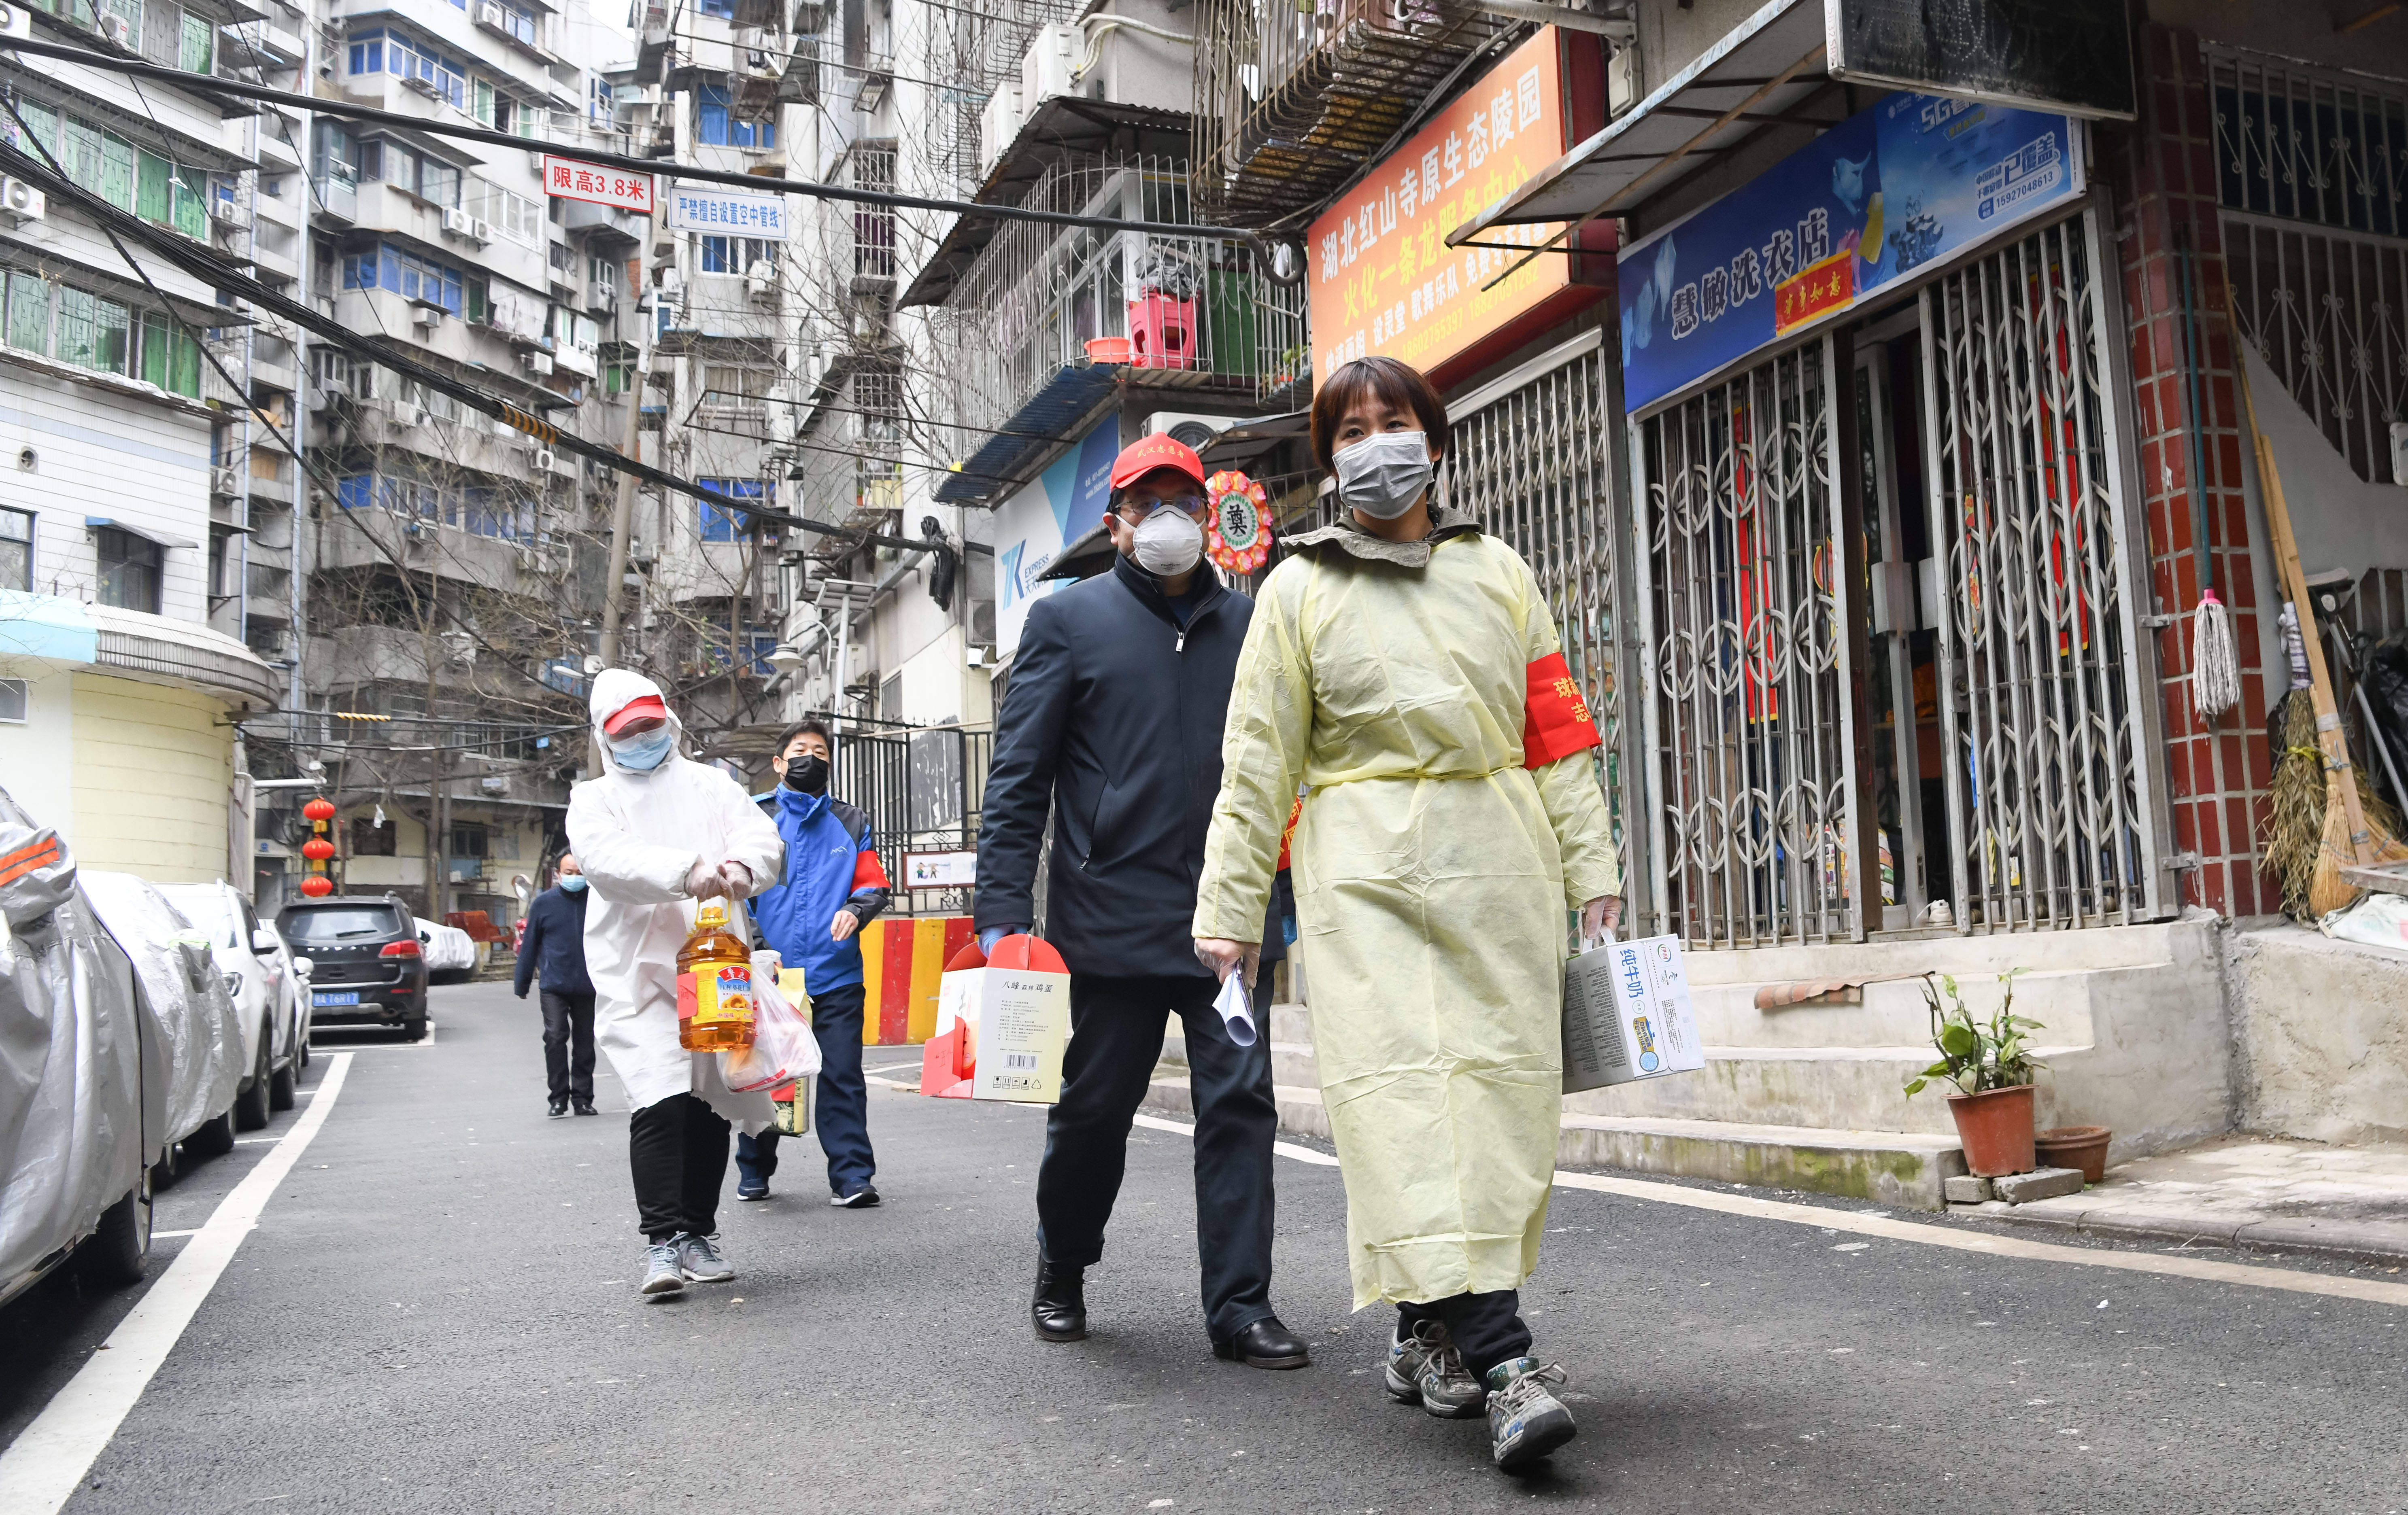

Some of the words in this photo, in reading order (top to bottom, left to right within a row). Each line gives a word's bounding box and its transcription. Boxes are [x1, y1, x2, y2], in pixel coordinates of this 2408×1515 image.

[1321, 64, 1541, 283] 湖北红山寺原生态陵园
[1976, 164, 2002, 185] 中国移动
[2004, 133, 2054, 185] 已覆盖
[553, 166, 644, 201] 限高3.8米
[1996, 171, 2053, 208] 15927048613
[679, 197, 779, 229] 严禁擅自设置空中管线
[1344, 155, 1528, 327] 火化一条龙服务中心
[1672, 208, 1829, 339] 慧敏洗衣店
[1373, 301, 1406, 347] 设灵堂
[1411, 263, 1459, 322] 歌舞乐队
[1784, 270, 1841, 319] 事事如意
[1402, 307, 1463, 363] 18602755397
[1137, 444, 1185, 459] 武汉志愿者
[1227, 504, 1248, 535] 奠
[1025, 554, 1049, 578] EXPRESS
[1571, 701, 1592, 722] 志
[1660, 946, 1668, 959] 伊利
[726, 968, 746, 979] 鲁花
[1001, 980, 1053, 993] 八峰森林鸡蛋
[1620, 948, 1644, 998] 纯牛奶
